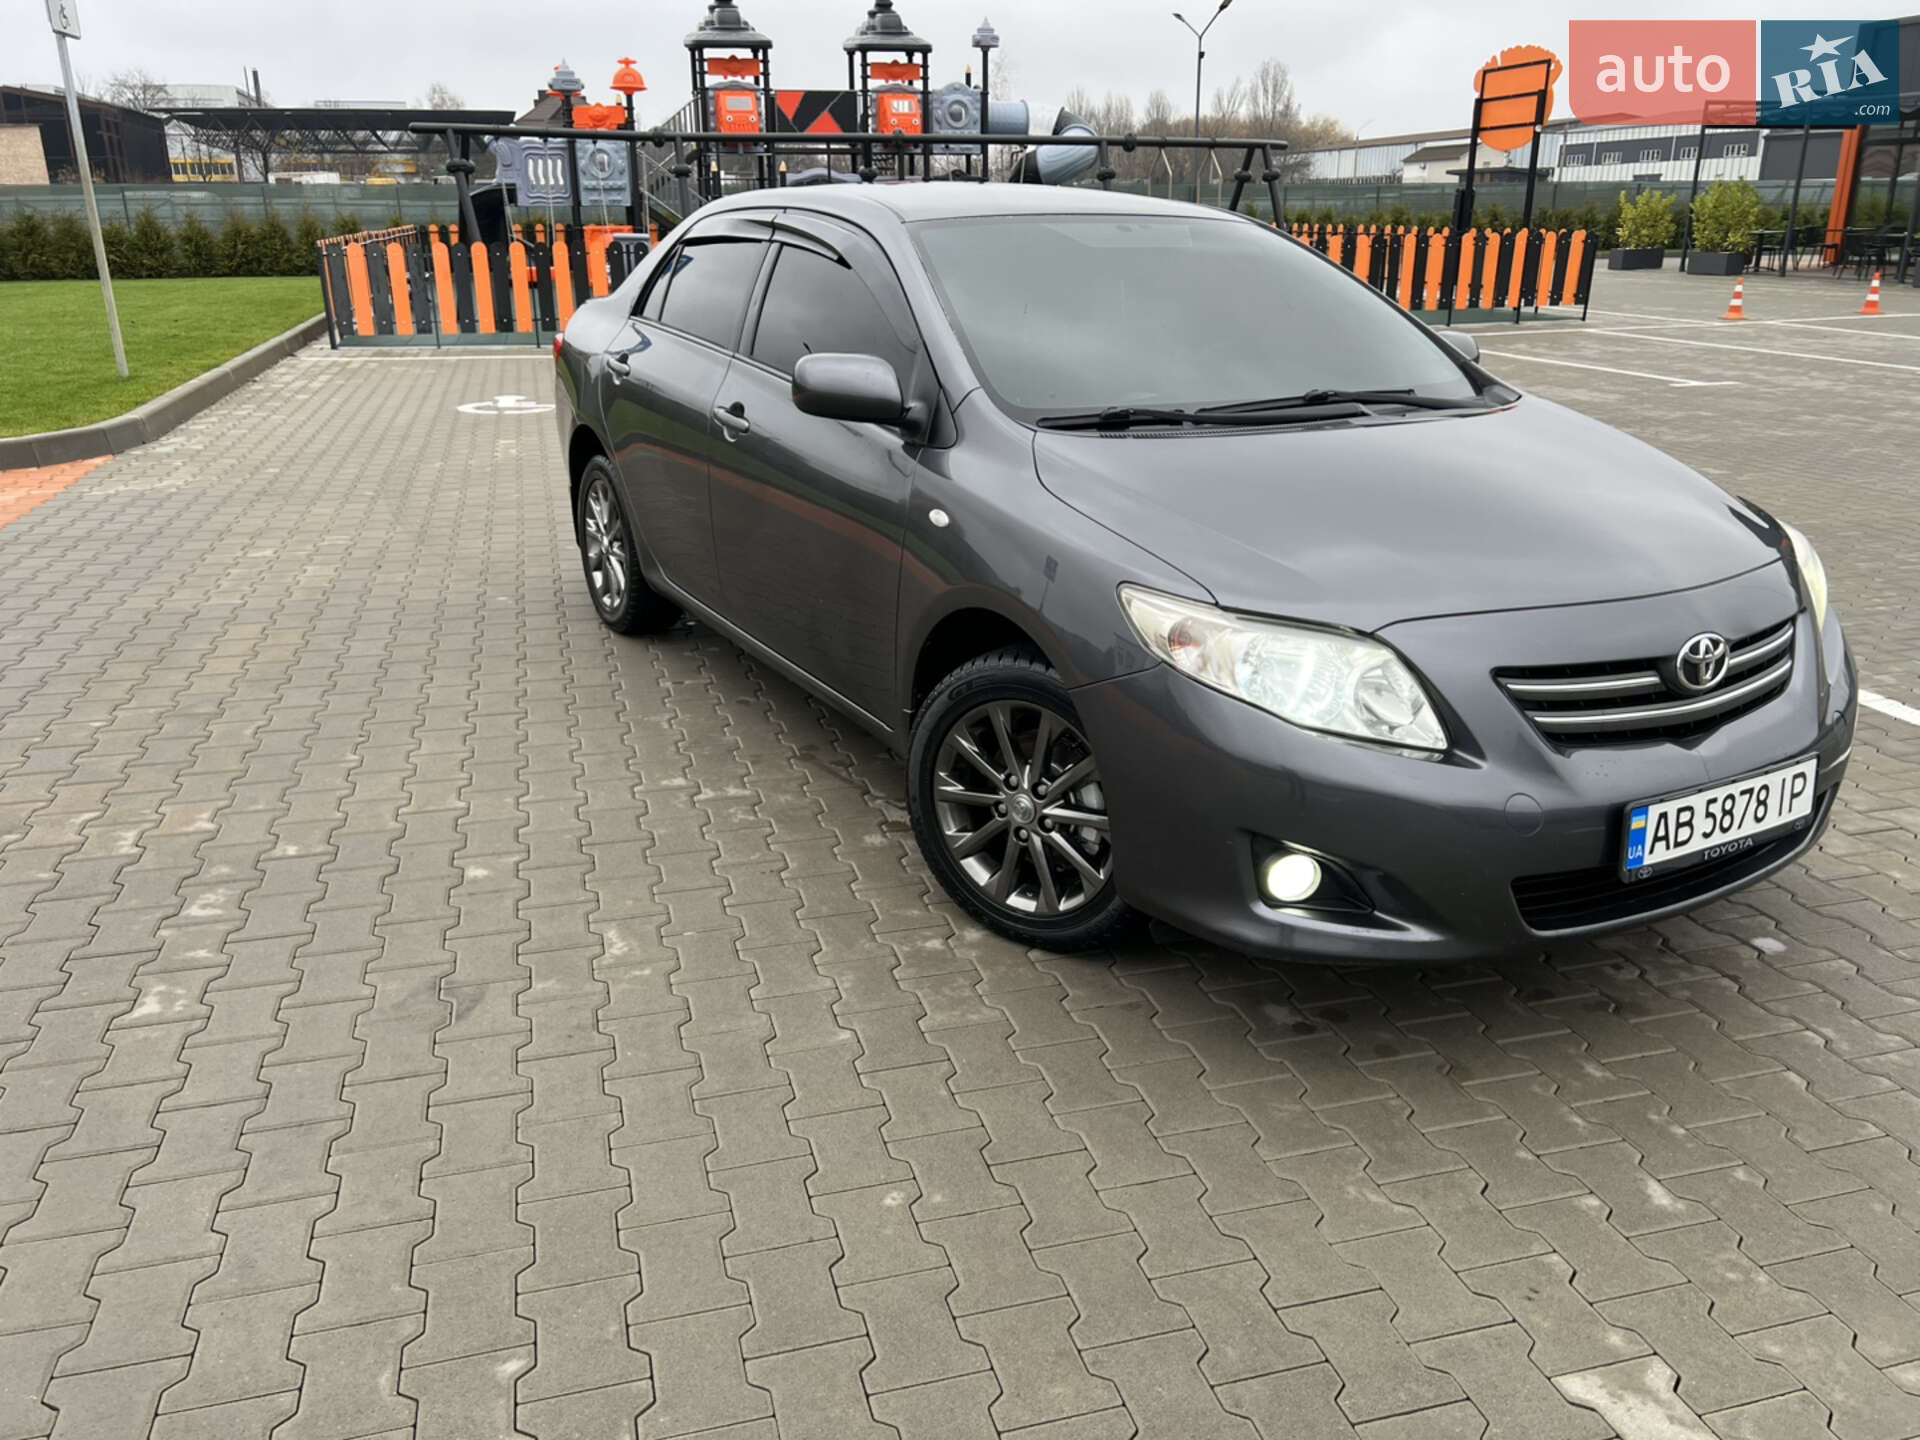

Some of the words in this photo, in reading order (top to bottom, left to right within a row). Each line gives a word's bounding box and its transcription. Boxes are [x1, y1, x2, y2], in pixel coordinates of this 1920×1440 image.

[1648, 805, 1694, 855] AB
[1702, 784, 1770, 839] 5878
[1778, 771, 1807, 817] IP
[1627, 844, 1643, 860] UA
[1703, 838, 1753, 861] TOYOTA
